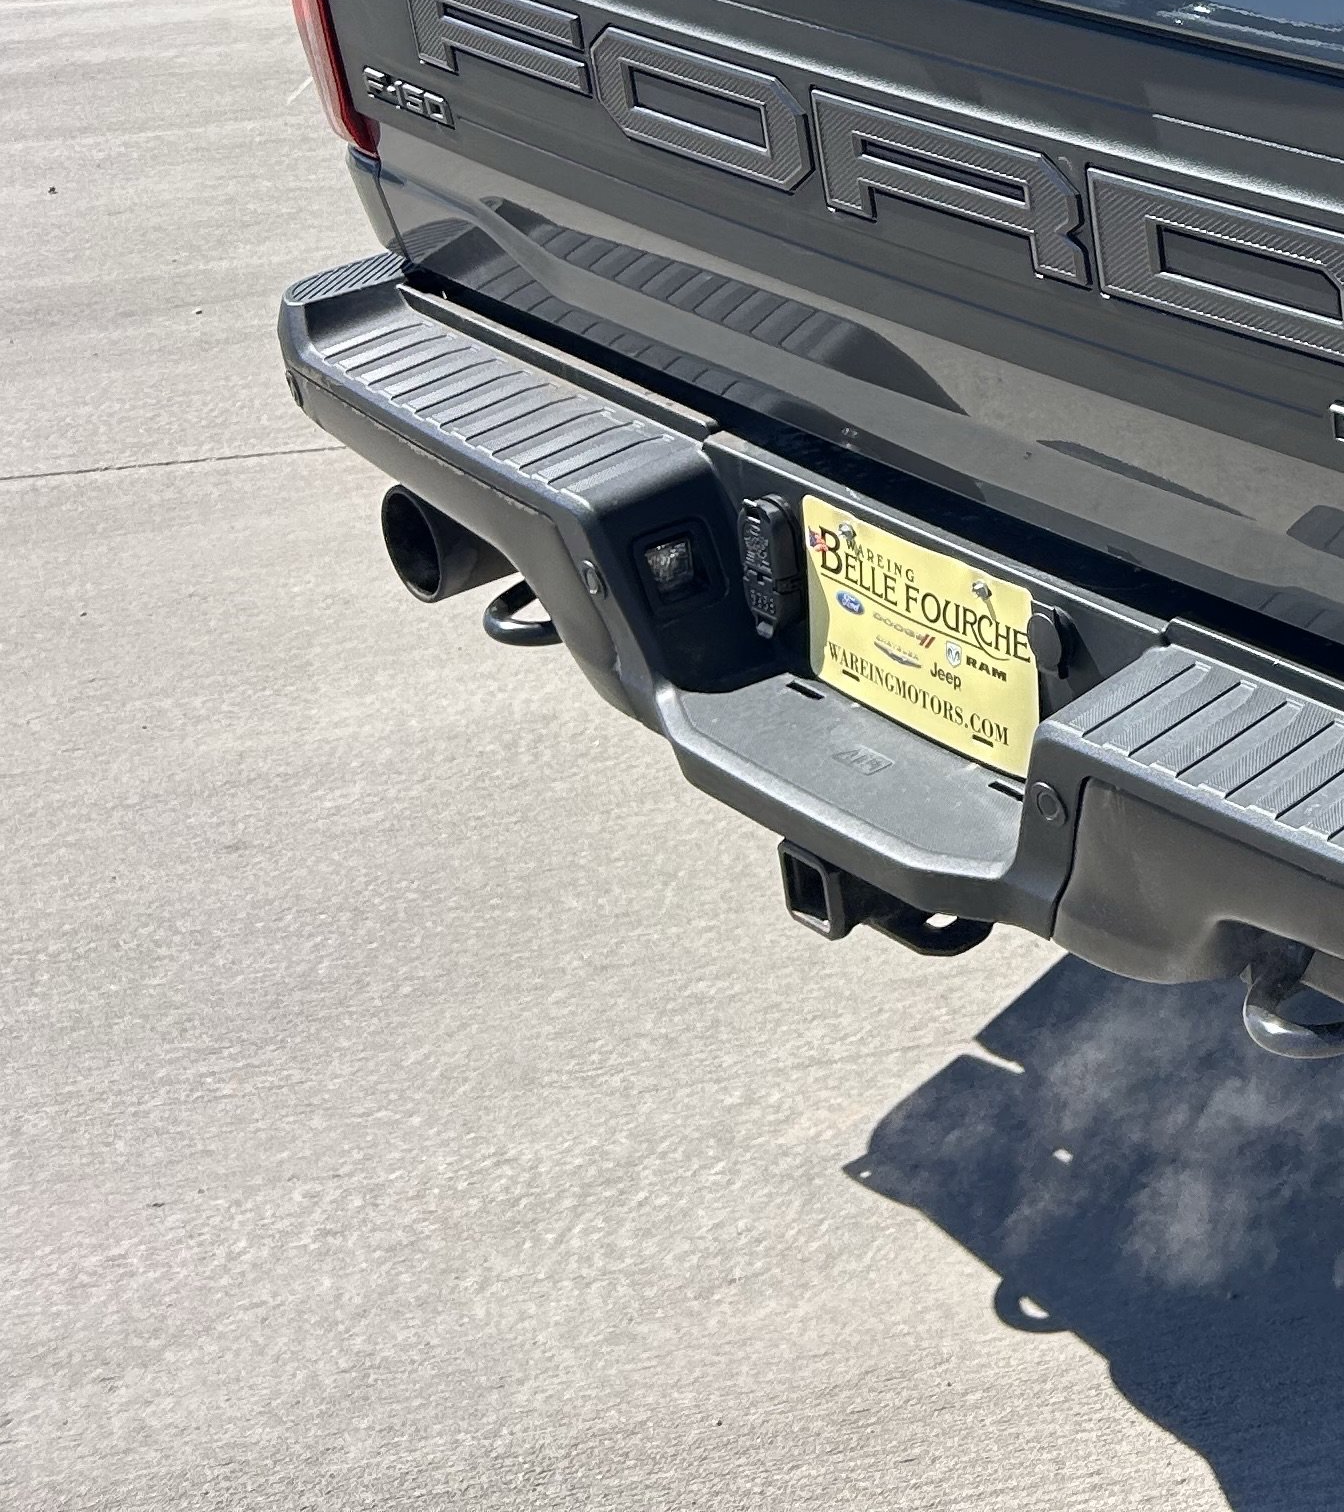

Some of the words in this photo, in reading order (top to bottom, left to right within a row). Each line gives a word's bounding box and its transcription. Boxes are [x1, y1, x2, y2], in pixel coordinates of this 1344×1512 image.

[363, 65, 456, 129] F-150
[846, 538, 915, 583] WAREING
[819, 525, 898, 607] BELLE
[905, 583, 1031, 663] FOURCHE
[840, 592, 862, 614] Ford
[930, 661, 961, 691] Jeep
[966, 655, 1007, 682] RAM
[828, 641, 1009, 746] WAREINGMOTORS.COM
